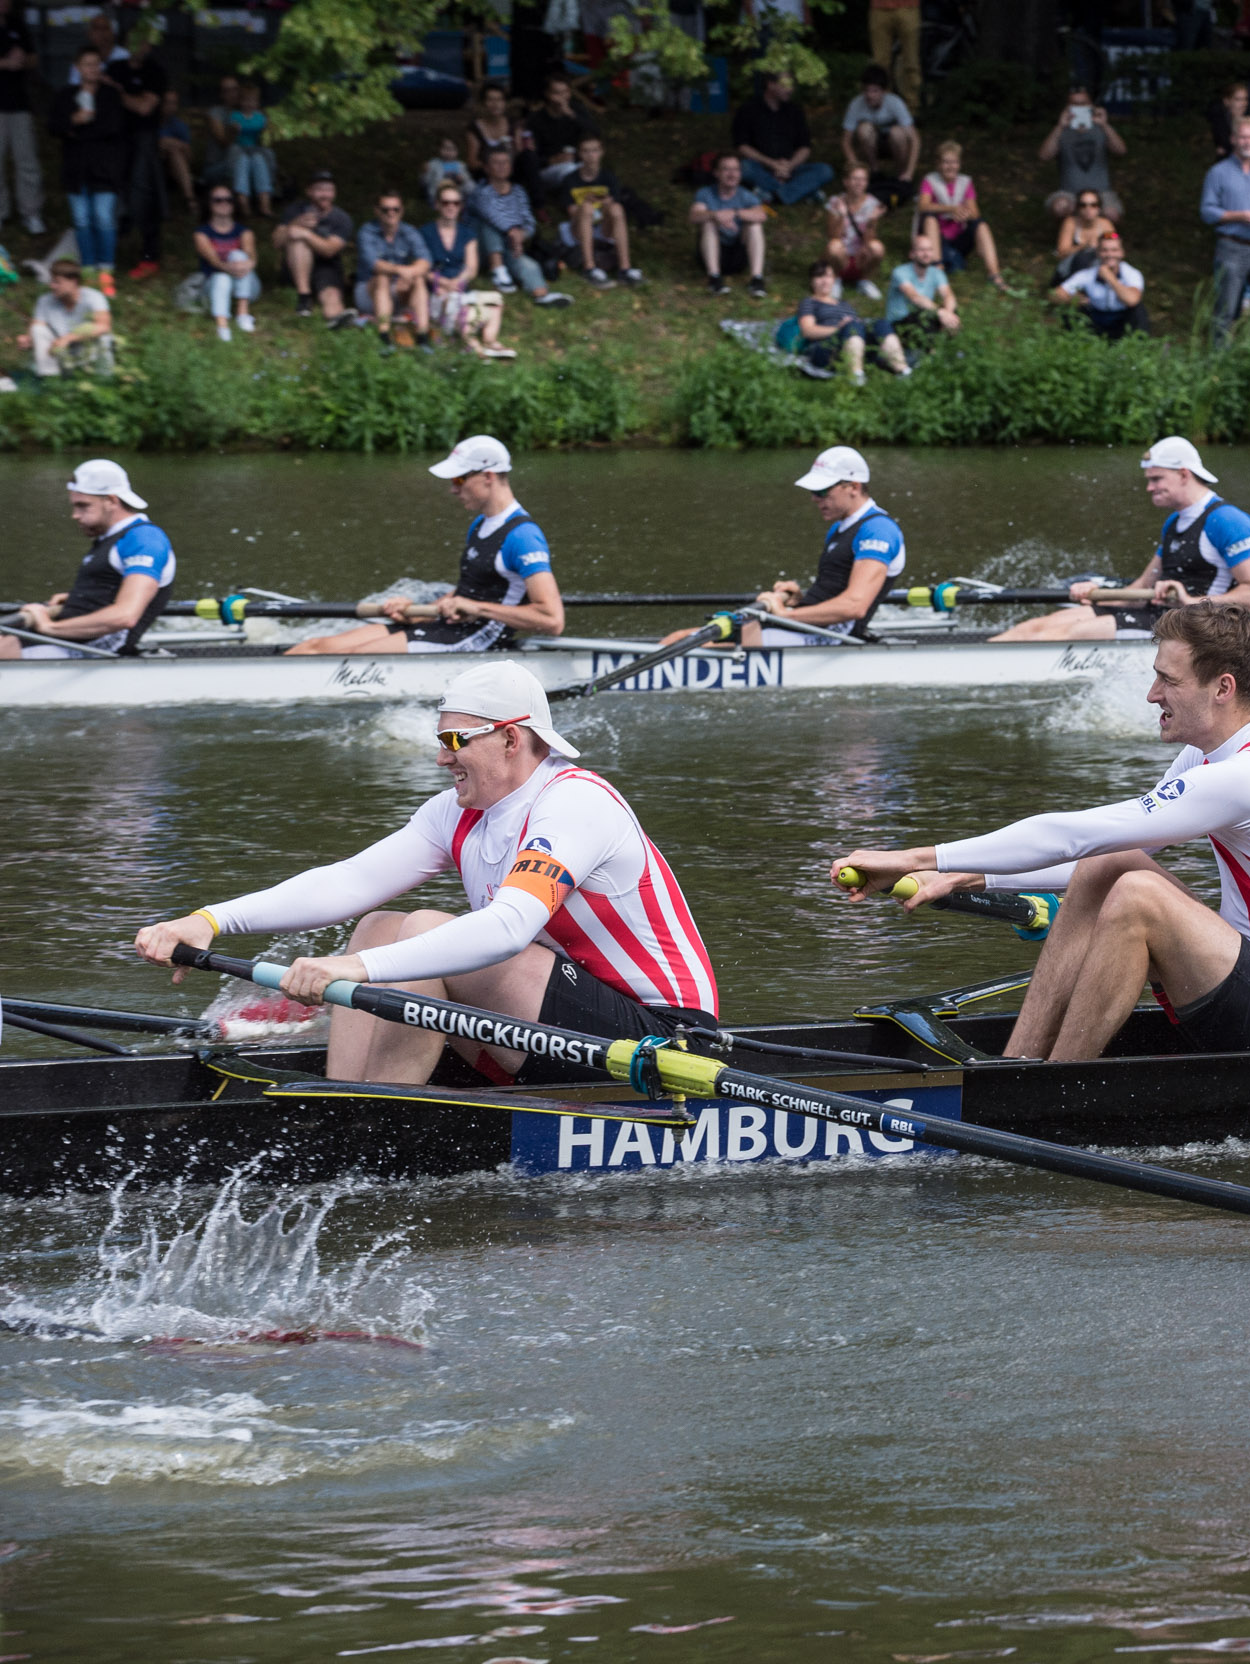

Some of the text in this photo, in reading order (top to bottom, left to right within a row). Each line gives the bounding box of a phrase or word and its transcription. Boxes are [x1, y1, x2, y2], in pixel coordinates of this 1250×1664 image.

[403, 1001, 600, 1068] BRUNCKHORST
[771, 1093, 838, 1120] SCHNELL.
[839, 1109, 873, 1126] GUT.
[890, 1118, 916, 1134] RBL
